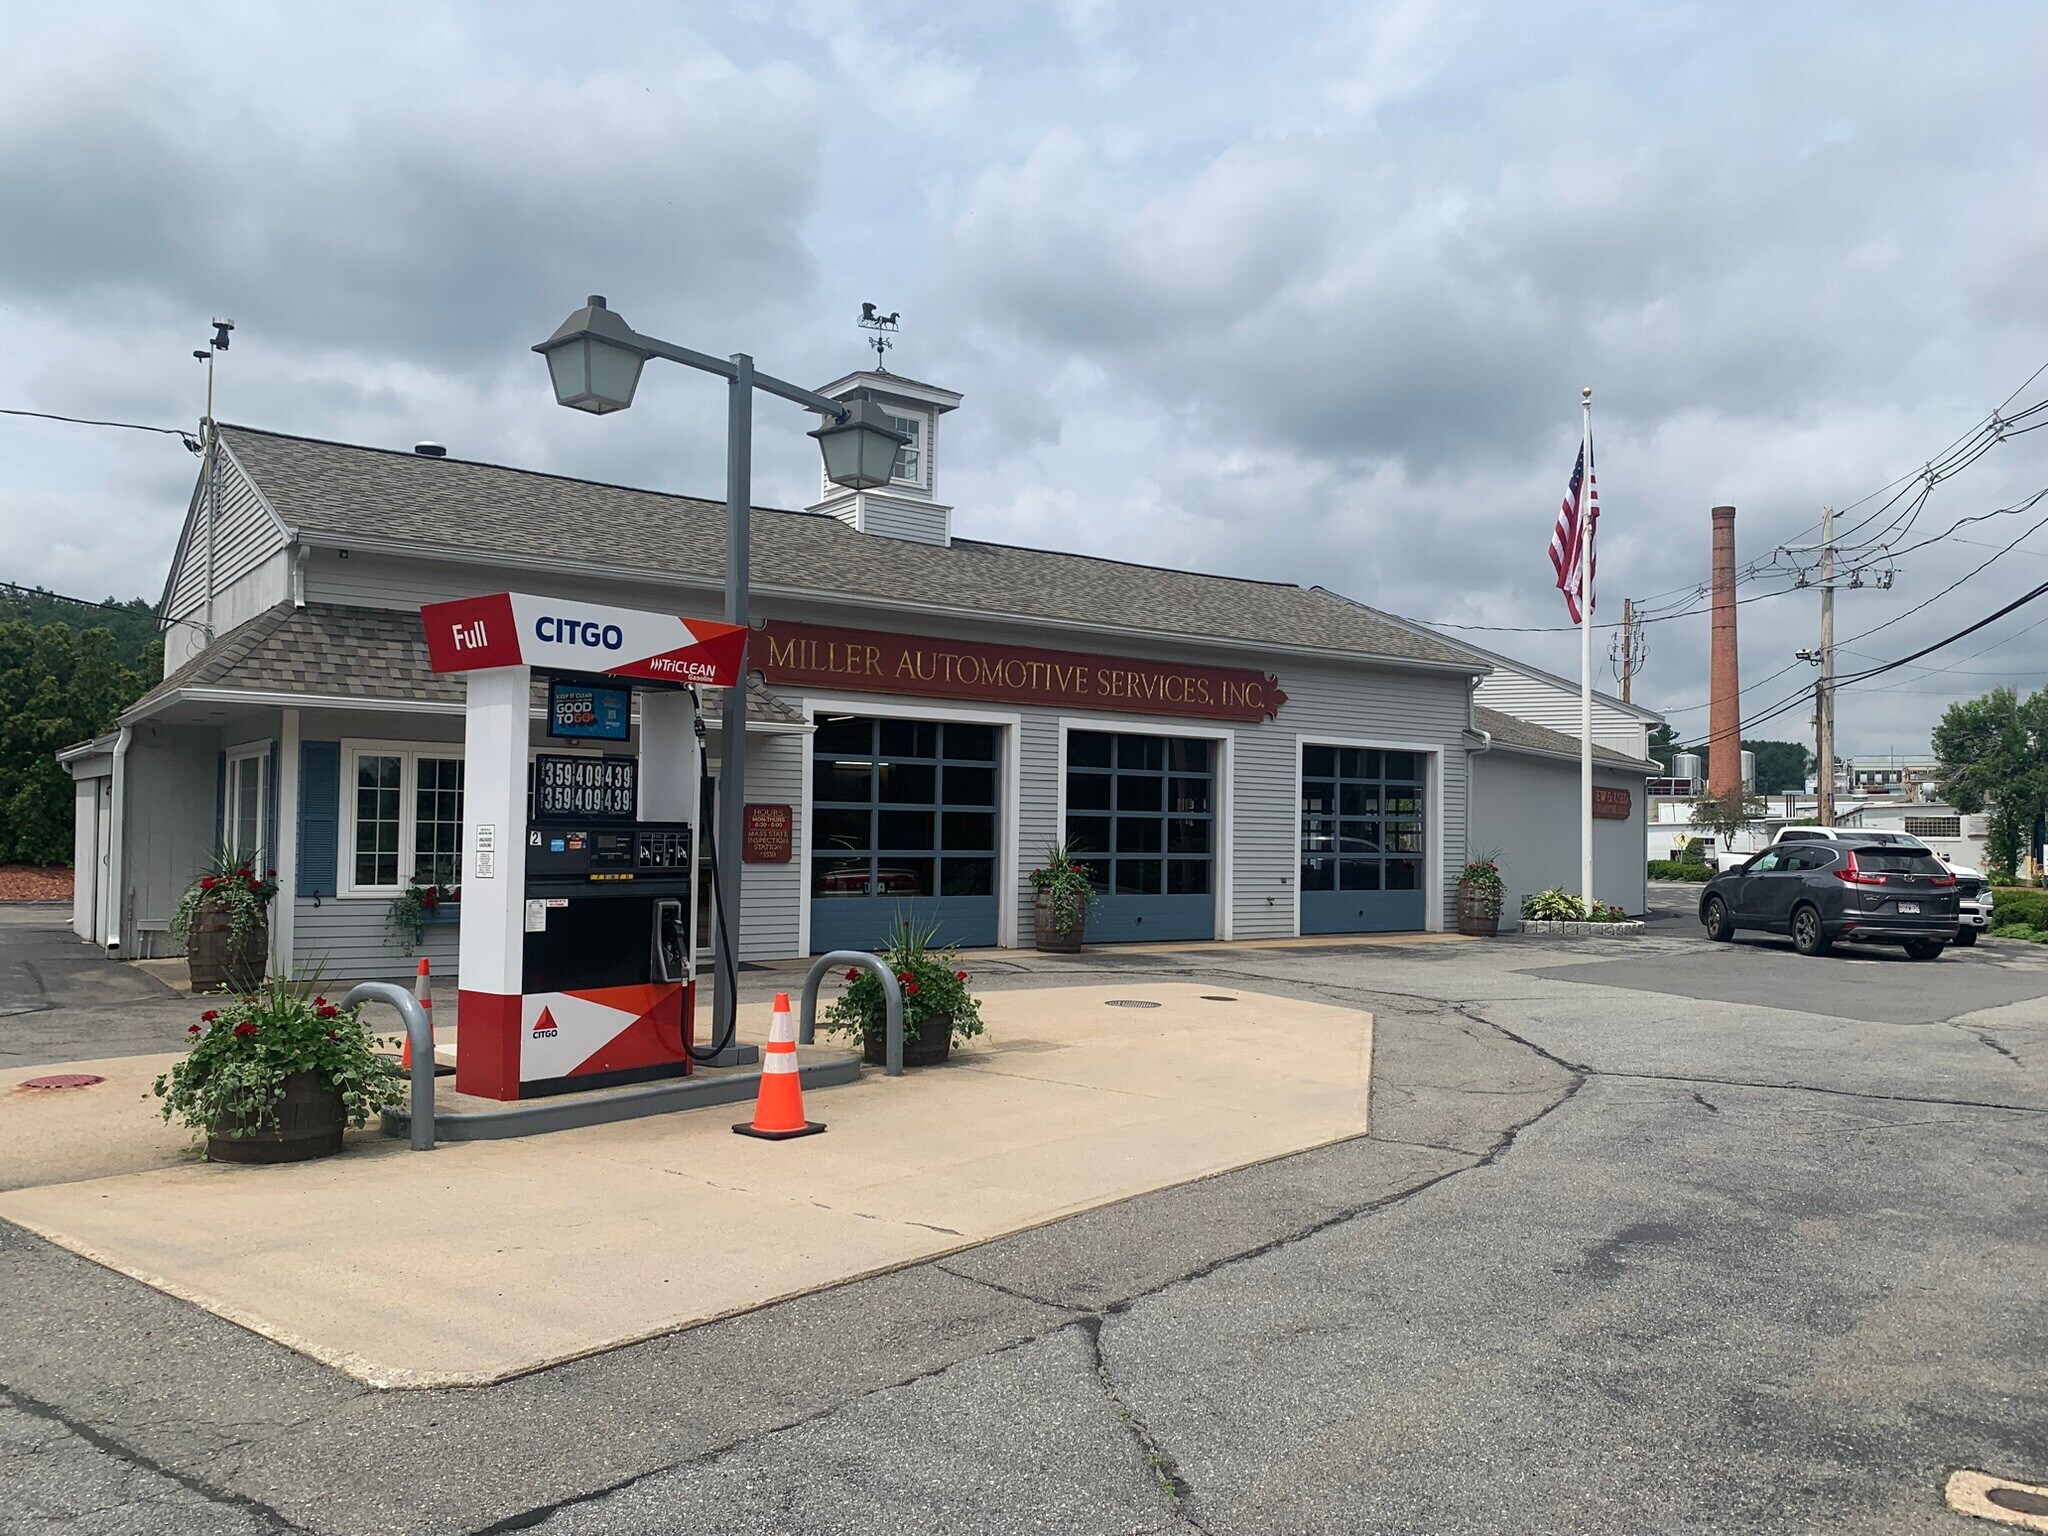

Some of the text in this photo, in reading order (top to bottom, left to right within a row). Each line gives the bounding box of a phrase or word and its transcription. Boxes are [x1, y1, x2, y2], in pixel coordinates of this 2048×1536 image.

[452, 620, 488, 651] Full
[535, 616, 623, 650] CITGO
[662, 658, 716, 677] TriCLEAN
[767, 635, 1266, 709] MILLER AUTOMOTIVE SERVICES, INC.
[687, 673, 714, 683] Gasoline
[556, 702, 592, 714] GOOD
[753, 809, 784, 817] HOURS
[532, 831, 539, 845] 2
[532, 1030, 558, 1039] CITGO
